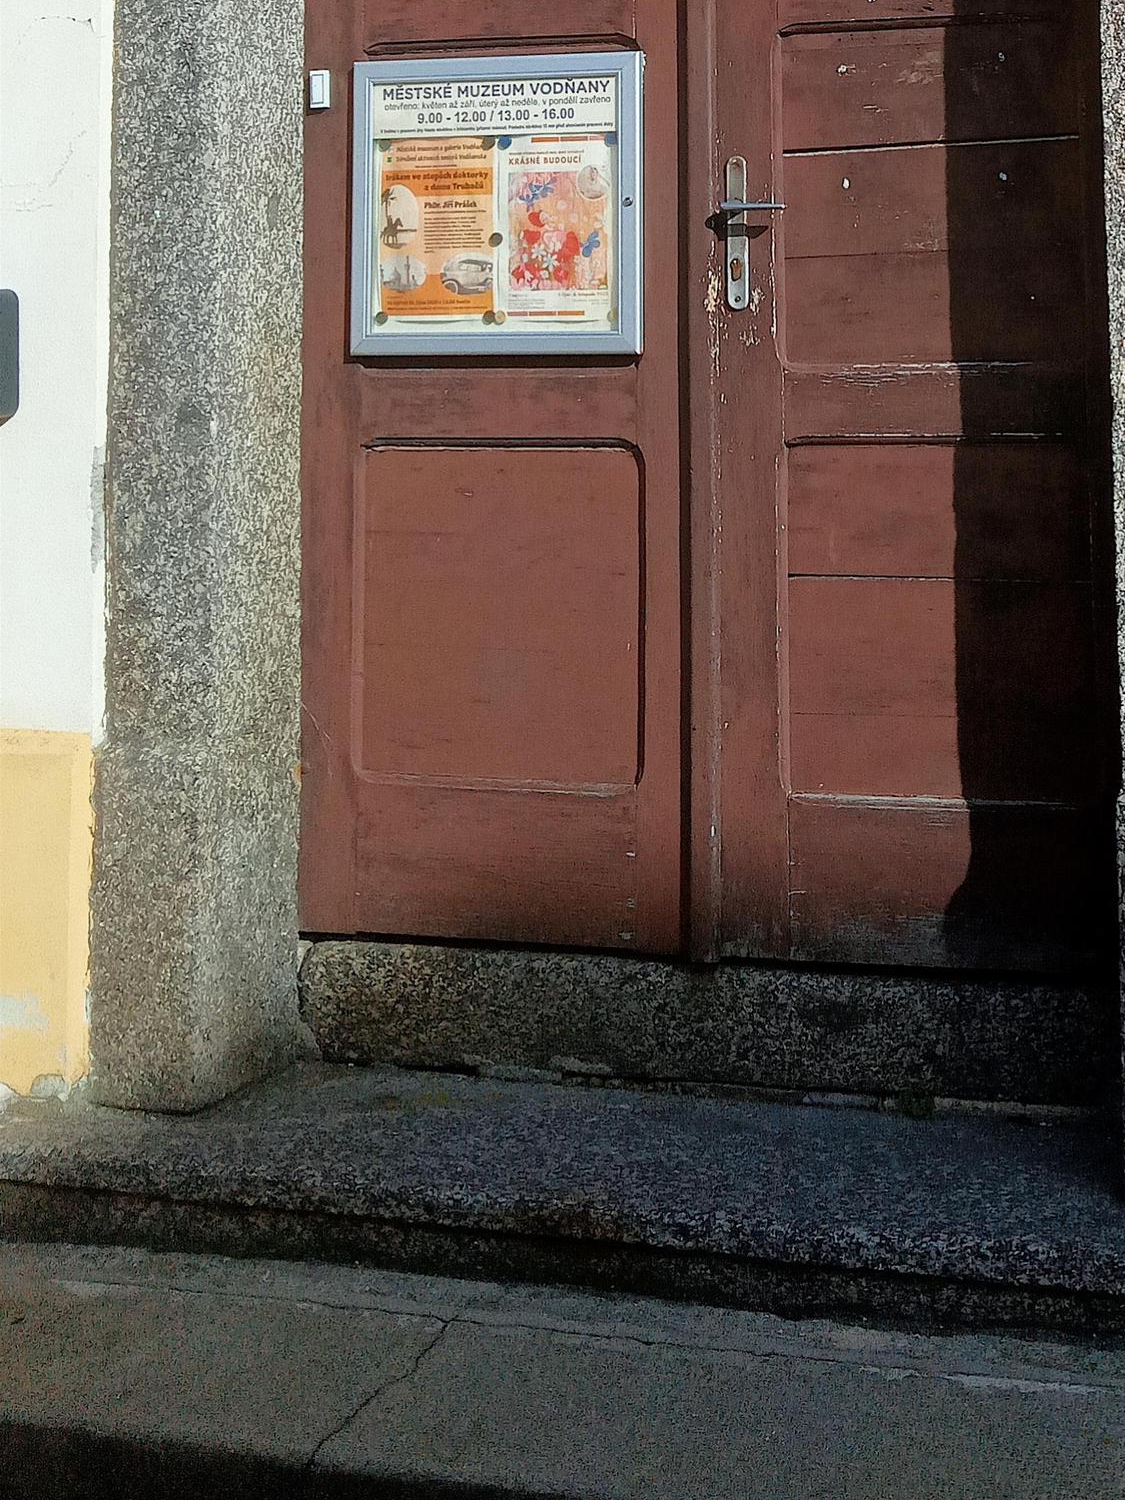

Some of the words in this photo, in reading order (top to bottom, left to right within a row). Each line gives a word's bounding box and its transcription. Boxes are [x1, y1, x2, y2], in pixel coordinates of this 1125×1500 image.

[383, 83, 452, 100] MĚSTSKÉ
[457, 84, 524, 98] MUZEUM
[530, 78, 610, 95] VODŇANY
[421, 100, 447, 110] květen
[449, 100, 458, 109] až
[479, 99, 498, 109] úterý
[500, 99, 509, 107] až
[549, 96, 578, 107] pondělí
[580, 95, 611, 104] zavřeno
[417, 112, 443, 124] 9.00
[454, 111, 486, 123] 12.00
[490, 111, 494, 121] /
[497, 110, 530, 121] 13.00
[542, 108, 574, 119] 16.00
[508, 156, 540, 165] KRÁSNÉ
[543, 154, 581, 164] BUDOUCÍ
[453, 170, 488, 180] doktorky
